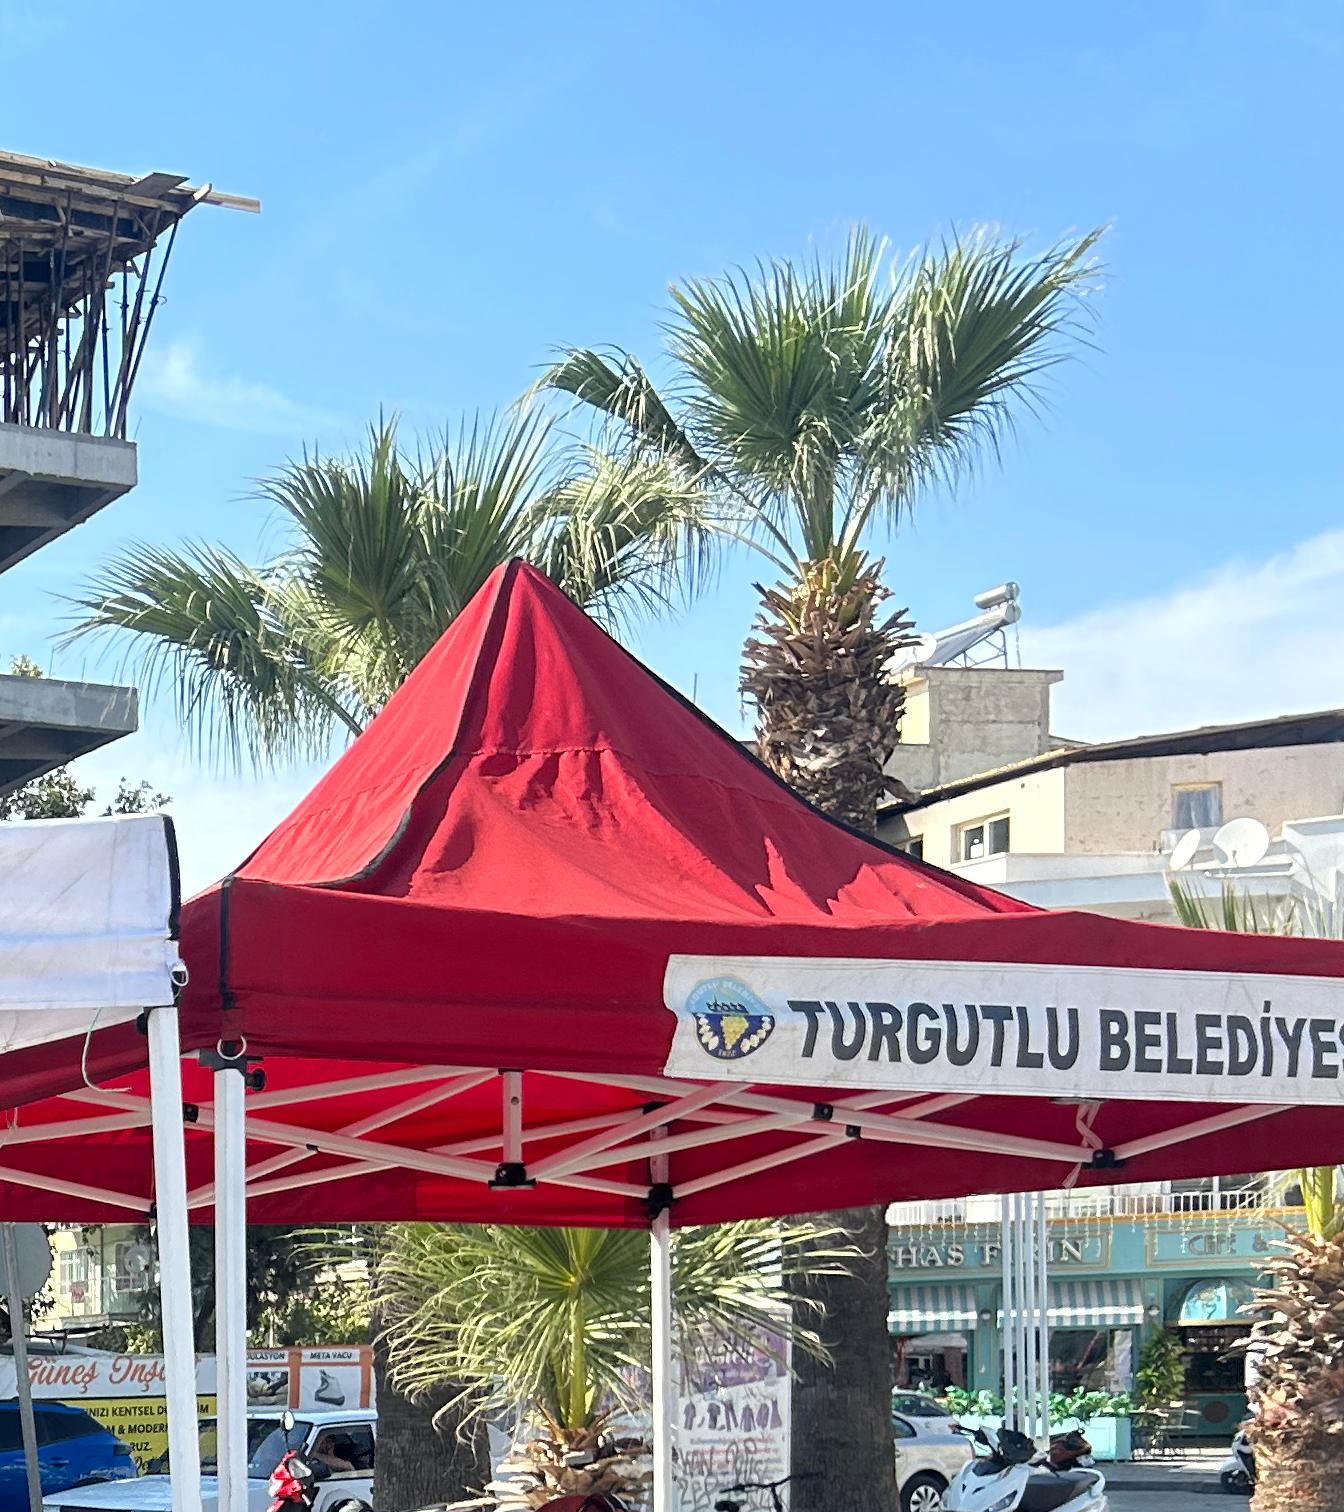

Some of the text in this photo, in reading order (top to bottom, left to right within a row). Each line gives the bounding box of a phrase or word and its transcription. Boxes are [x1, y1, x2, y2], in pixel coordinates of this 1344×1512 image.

[787, 1000, 1344, 1080] TURGUTLU BELEDİYE
[981, 1240, 1084, 1267] FIN
[112, 1405, 155, 1417] KENTSEL
